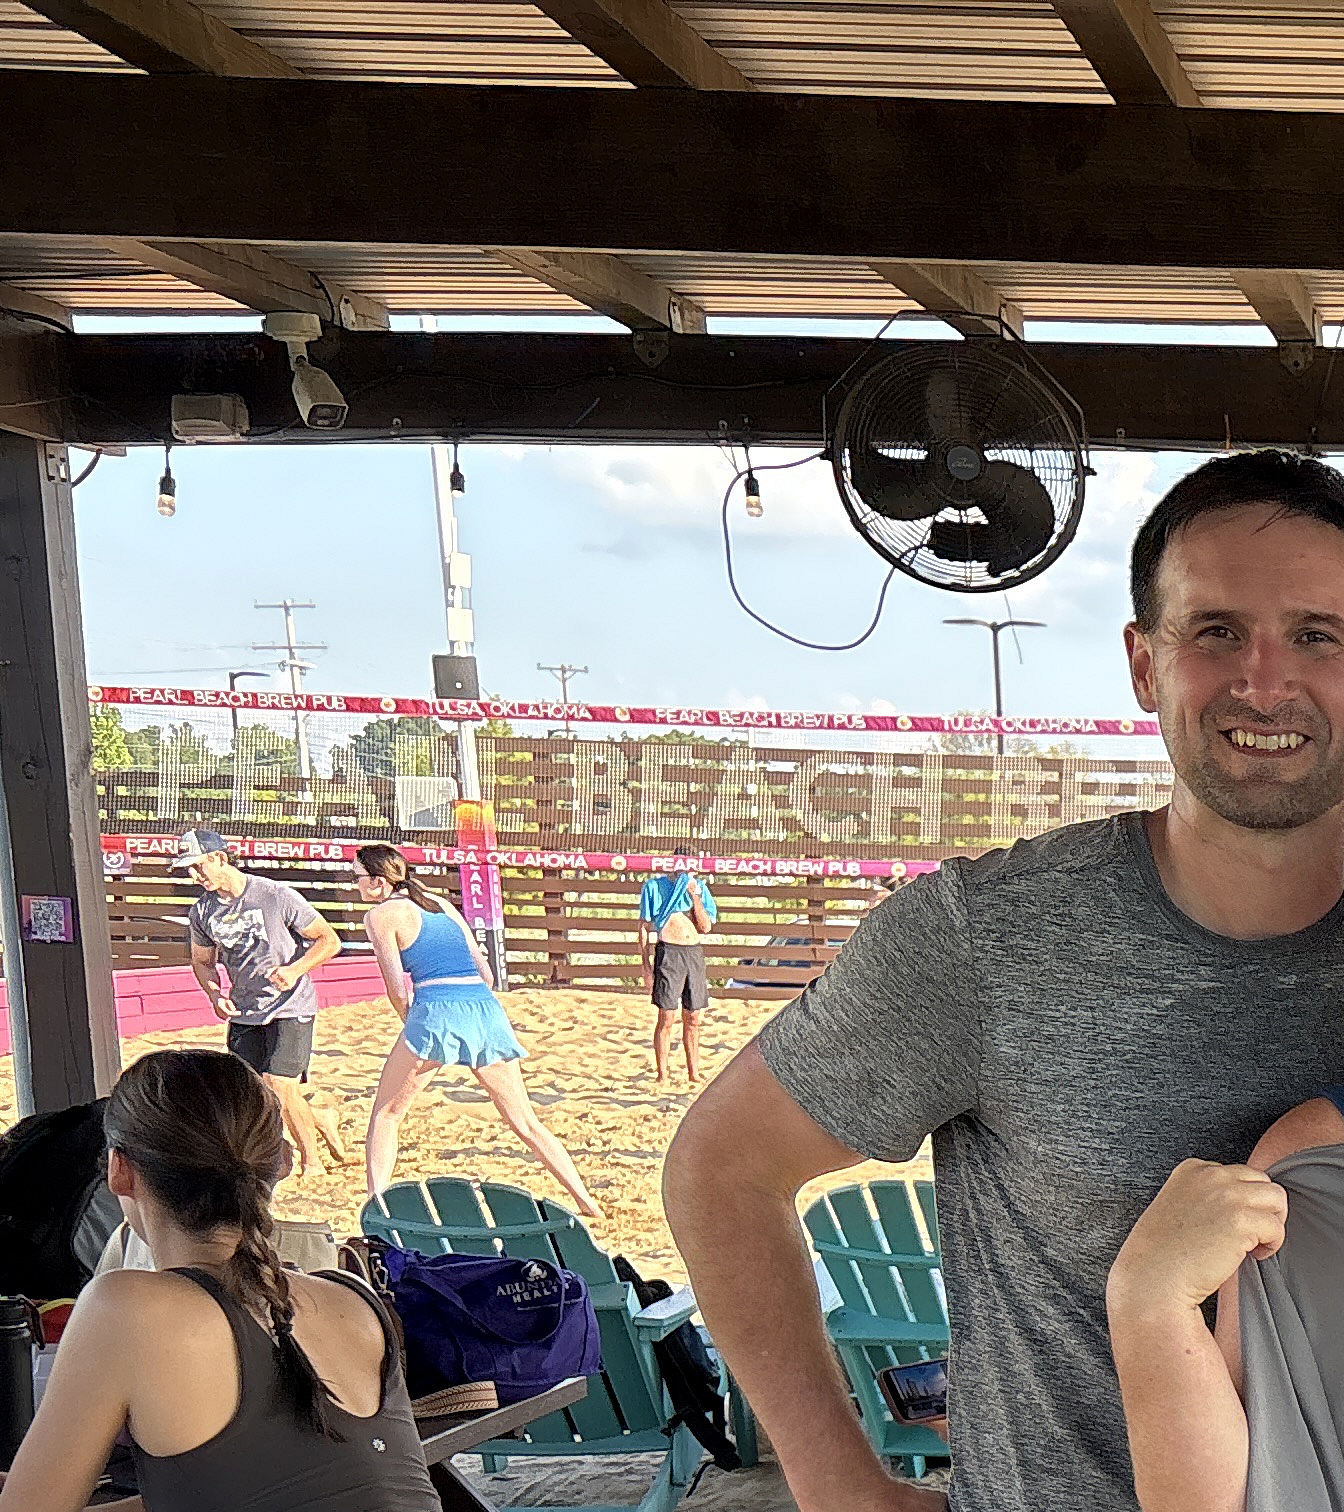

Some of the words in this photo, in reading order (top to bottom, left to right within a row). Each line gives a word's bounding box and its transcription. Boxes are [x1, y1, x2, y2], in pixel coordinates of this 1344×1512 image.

[129, 688, 188, 704] PEARL
[194, 690, 254, 706] BEACH
[256, 693, 307, 709] BREW
[313, 695, 347, 710] PUB
[490, 702, 592, 719] OKLAHOMA
[655, 708, 716, 724] PEARL
[720, 710, 777, 726] BEACH
[248, 840, 303, 857] BREW
[309, 844, 343, 860] PUB
[486, 851, 588, 868] OKLAHOMA
[651, 857, 710, 873] PEARL
[714, 859, 772, 874] BEACH
[775, 860, 823, 876] BREW
[828, 861, 861, 877] PUB
